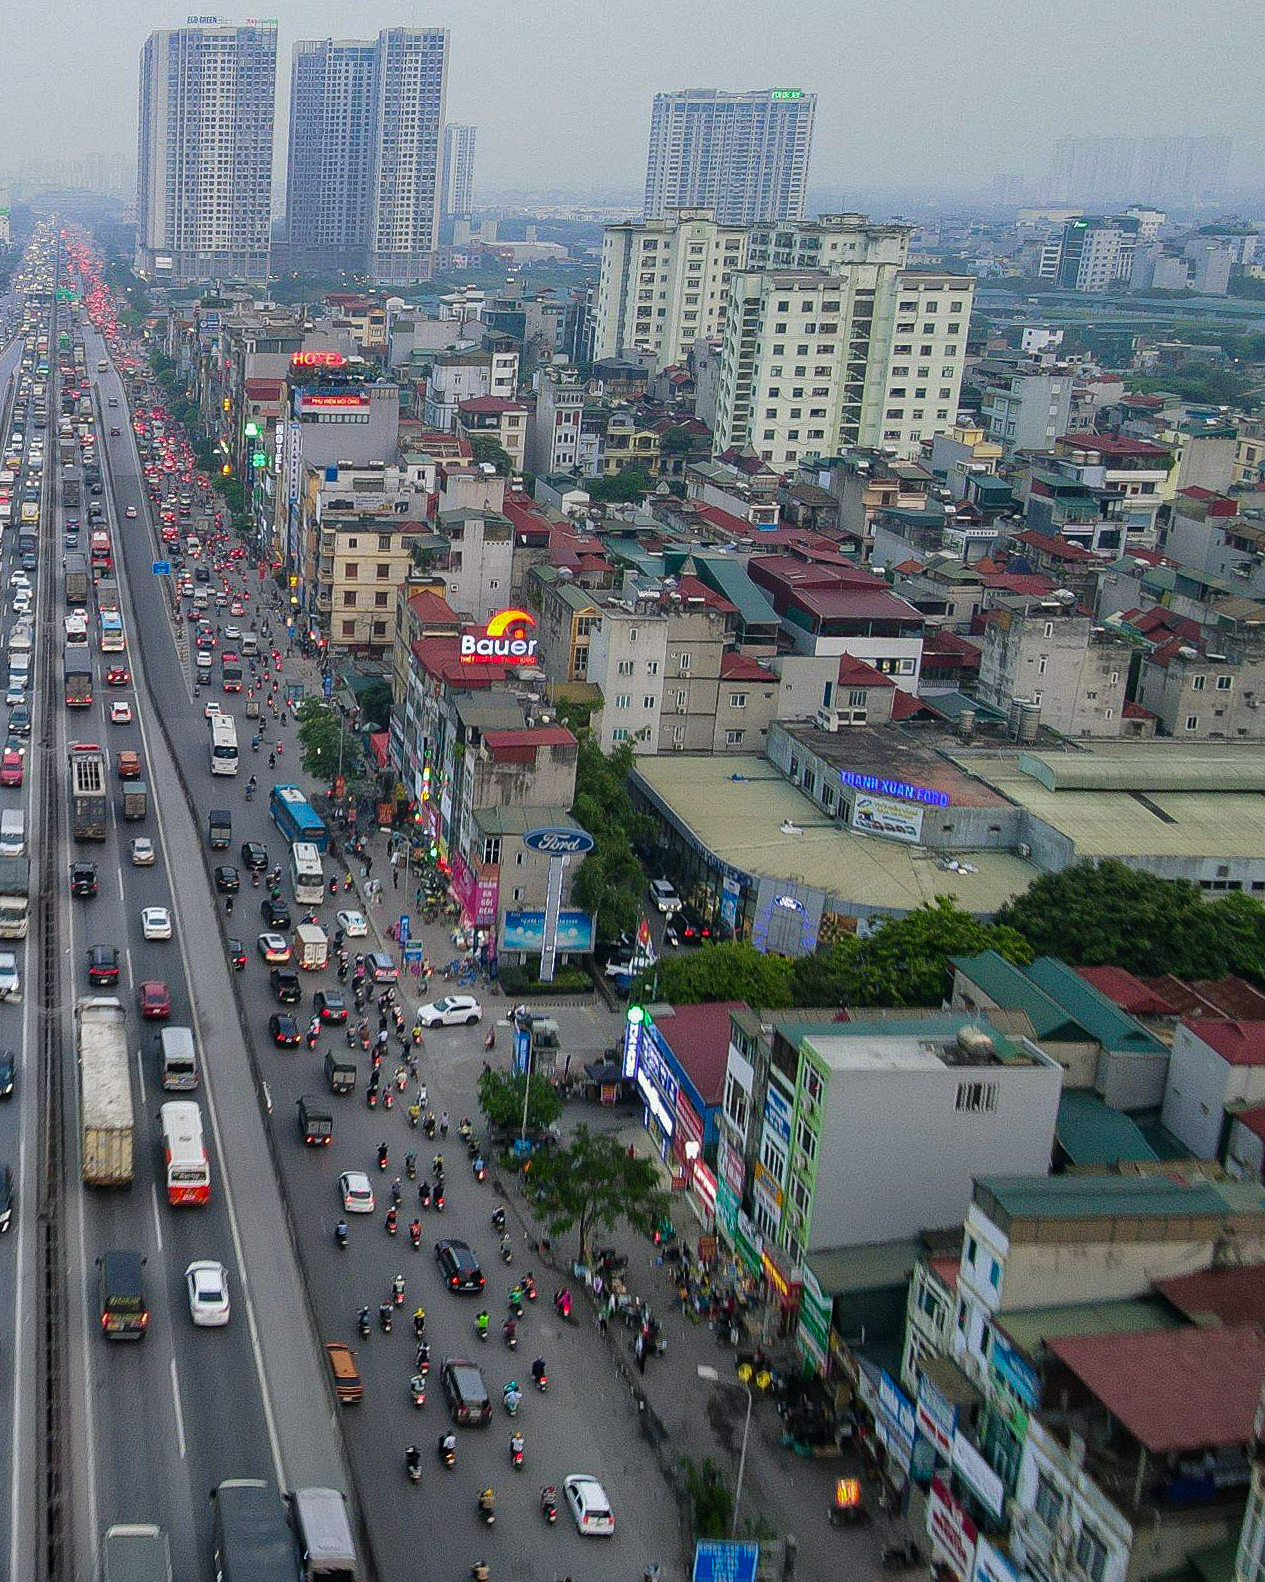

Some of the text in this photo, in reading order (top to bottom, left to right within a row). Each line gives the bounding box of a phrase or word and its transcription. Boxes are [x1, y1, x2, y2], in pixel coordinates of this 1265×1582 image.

[293, 352, 347, 365] HOTEL
[461, 635, 537, 656] Bauer
[538, 834, 581, 851] Ford
